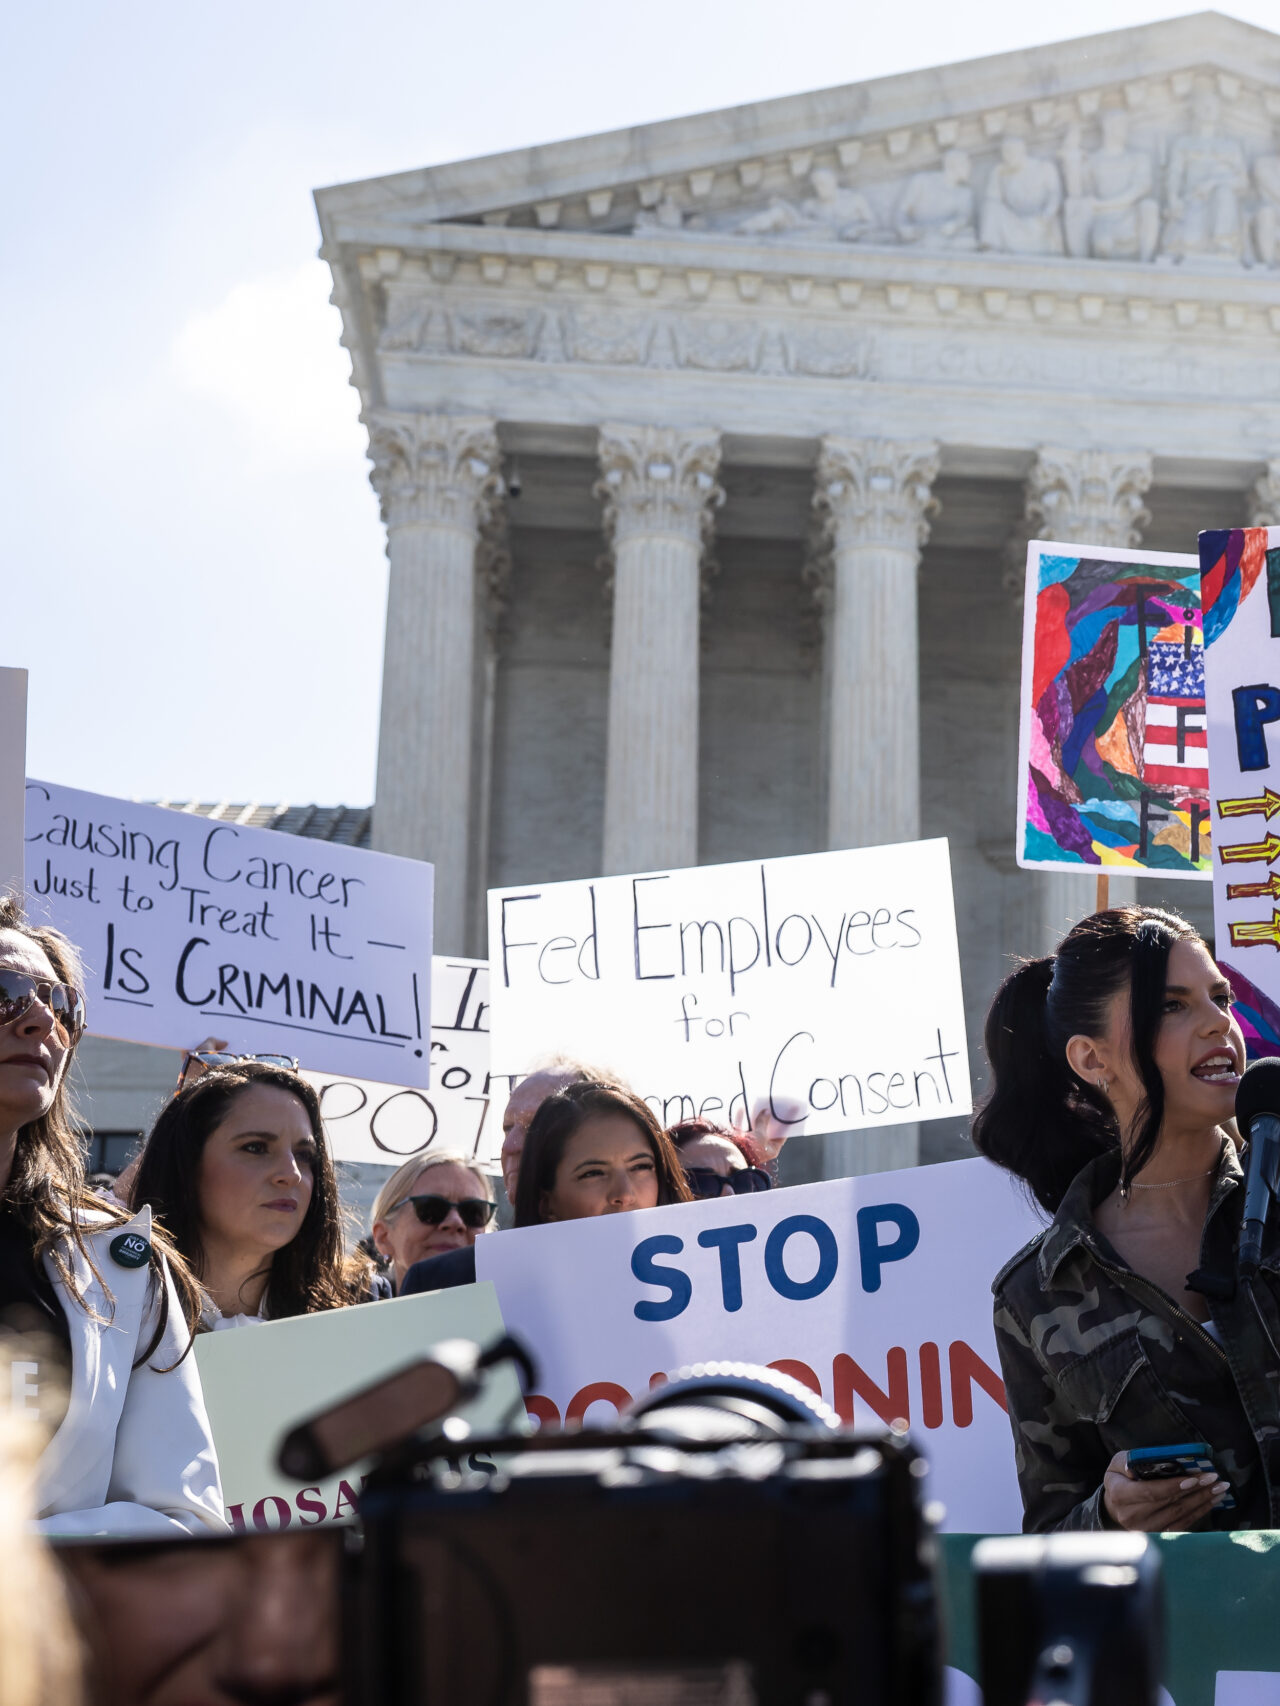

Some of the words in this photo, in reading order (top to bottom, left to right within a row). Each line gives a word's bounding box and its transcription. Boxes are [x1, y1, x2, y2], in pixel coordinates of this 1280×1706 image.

[25, 784, 181, 891] Causing
[203, 826, 366, 908] Cancer
[34, 859, 102, 905] Just
[117, 874, 154, 913] to
[180, 885, 280, 942] Treat
[310, 913, 355, 961] It
[501, 885, 602, 988] Fed
[633, 863, 922, 996] Employees
[174, 936, 425, 1059] CRIMINAL!
[673, 992, 751, 1043] for
[768, 1027, 960, 1126] Consent
[123, 1237, 145, 1252] NO
[631, 1202, 921, 1323] STOP
